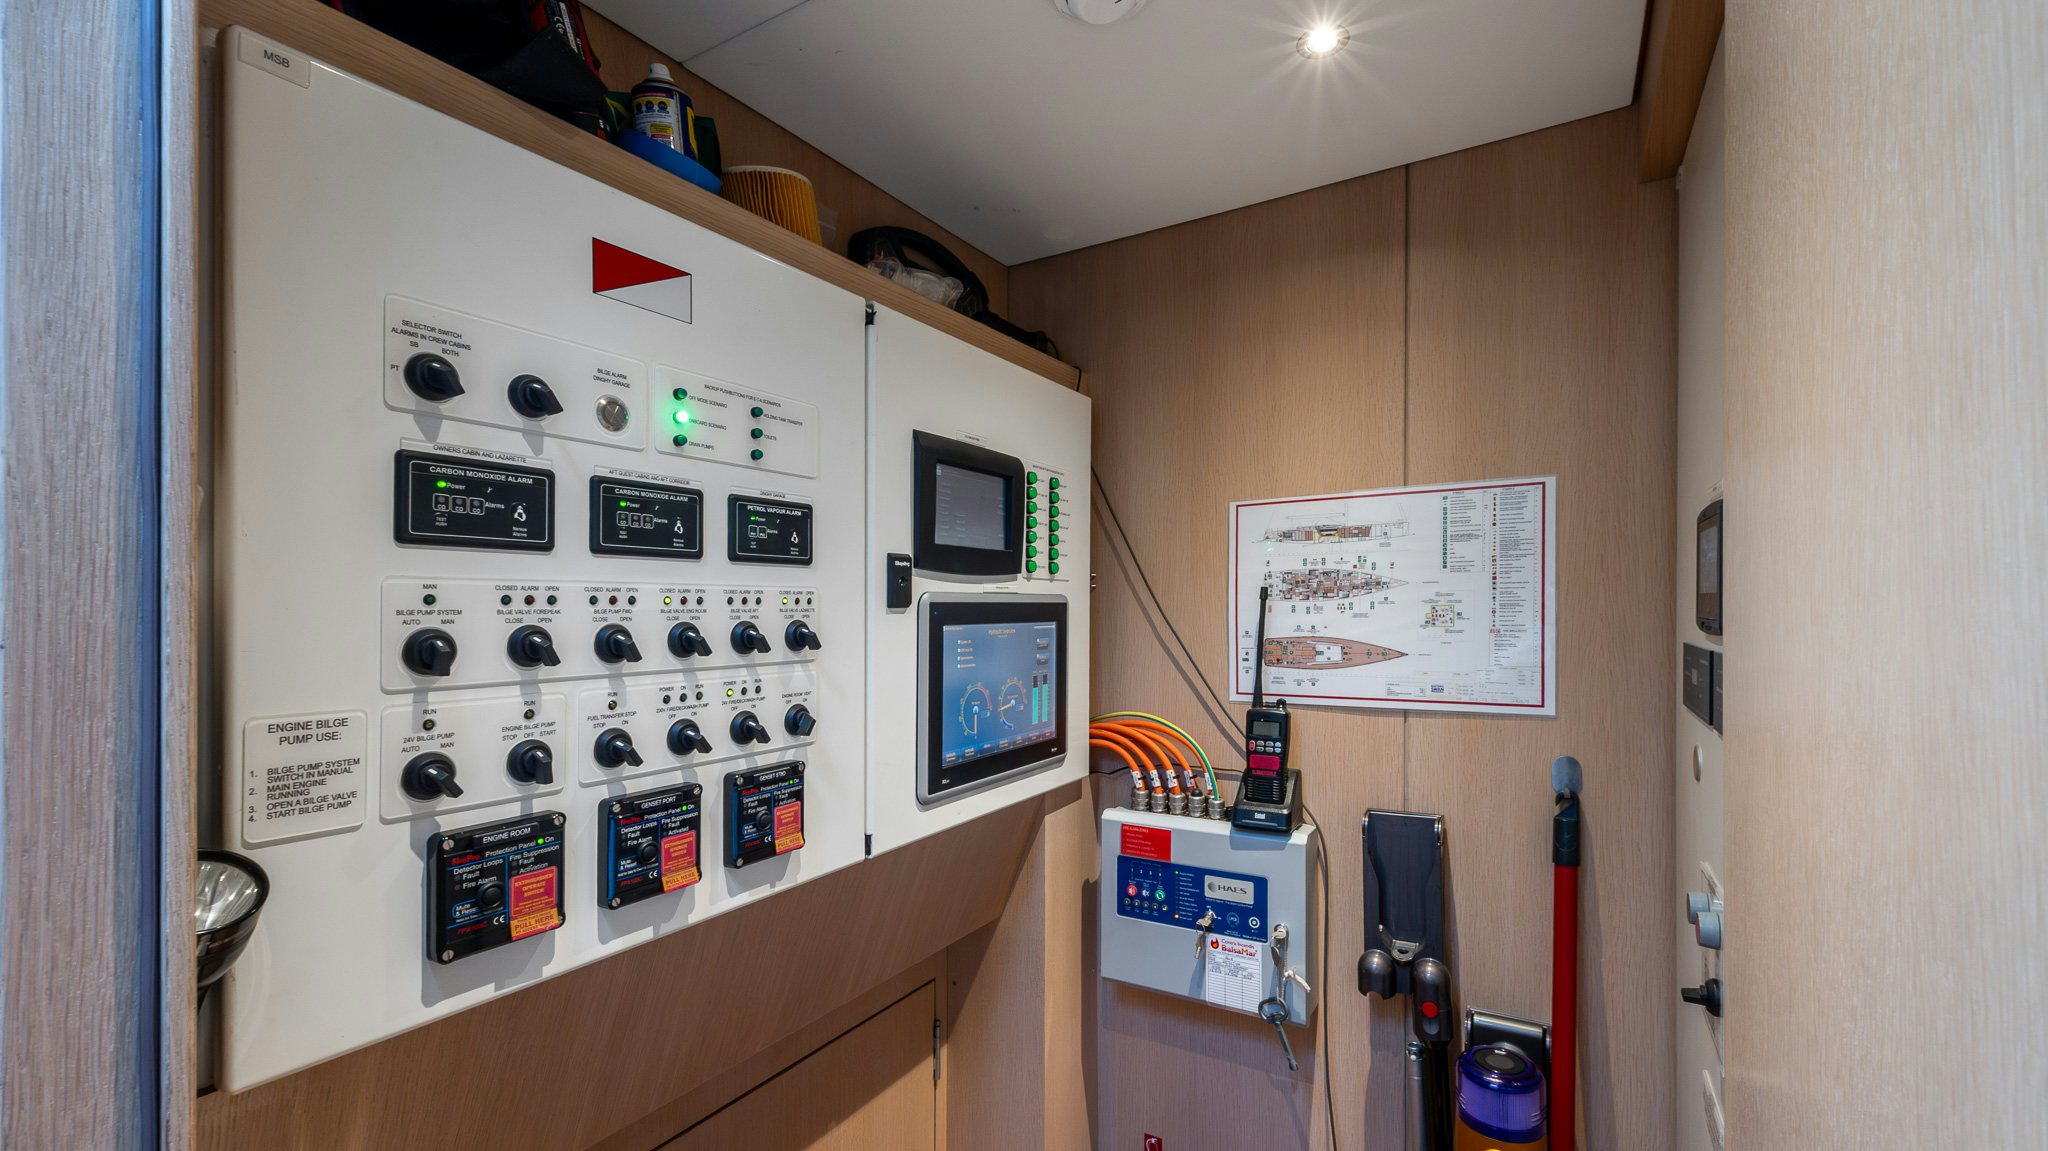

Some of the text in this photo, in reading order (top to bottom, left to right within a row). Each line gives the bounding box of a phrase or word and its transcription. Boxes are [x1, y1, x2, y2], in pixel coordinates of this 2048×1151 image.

[264, 49, 290, 68] MSB
[401, 320, 462, 339] SELECTOR SWITCH
[391, 327, 471, 351] ALARMS IN CREW CABINS
[410, 340, 419, 348] SB
[442, 348, 459, 357] BOTH
[597, 368, 627, 380] BILGE ALARM
[593, 375, 630, 388] DINGHY GARAGE
[433, 444, 527, 463] OWNERS CABIN AND LAZARETTE
[430, 466, 533, 484] CARBON MONOXIDE ALARM
[447, 482, 466, 490] Power
[615, 488, 688, 502] CARBON MONOXIDE ALARM
[600, 712, 624, 720] TRANSFER
[268, 718, 349, 734] ENGINE BILGE
[502, 721, 556, 733] ENGINE BILGE PUMP
[279, 732, 342, 745] PUMP USE:
[403, 732, 455, 744] 24V BILGE PUMP
[267, 765, 295, 776] BILGE
[297, 762, 323, 772] PUMP
[325, 758, 360, 769] SYSTEM
[267, 767, 353, 784] SWITCH IN MANUAL
[267, 782, 290, 793] MAIN
[292, 778, 327, 790] ENGINE
[266, 799, 293, 811] OPEN
[295, 798, 301, 807] A
[303, 794, 329, 806] BILGE
[331, 791, 358, 802] VALVE
[267, 788, 310, 801] RUNNING
[641, 796, 676, 809] GENSET PORT
[266, 808, 296, 820] START
[298, 804, 324, 815] BILGE
[327, 800, 352, 811] PUMP
[671, 812, 698, 822] Suppression
[621, 821, 657, 834] Detector Loops
[483, 827, 531, 844] ENGINE ROOM
[638, 836, 652, 844] Alarm
[485, 845, 518, 858] Protection
[518, 841, 537, 851] Panel
[509, 844, 560, 861] Fire Suppression
[453, 859, 503, 875] Detector Loops
[519, 857, 534, 866] Fault
[519, 862, 548, 874] Activation
[462, 871, 480, 880] Fault
[462, 875, 497, 889] Fire Alarm
[1218, 884, 1247, 894] HAES
[1221, 944, 1256, 957] BalsaMar
